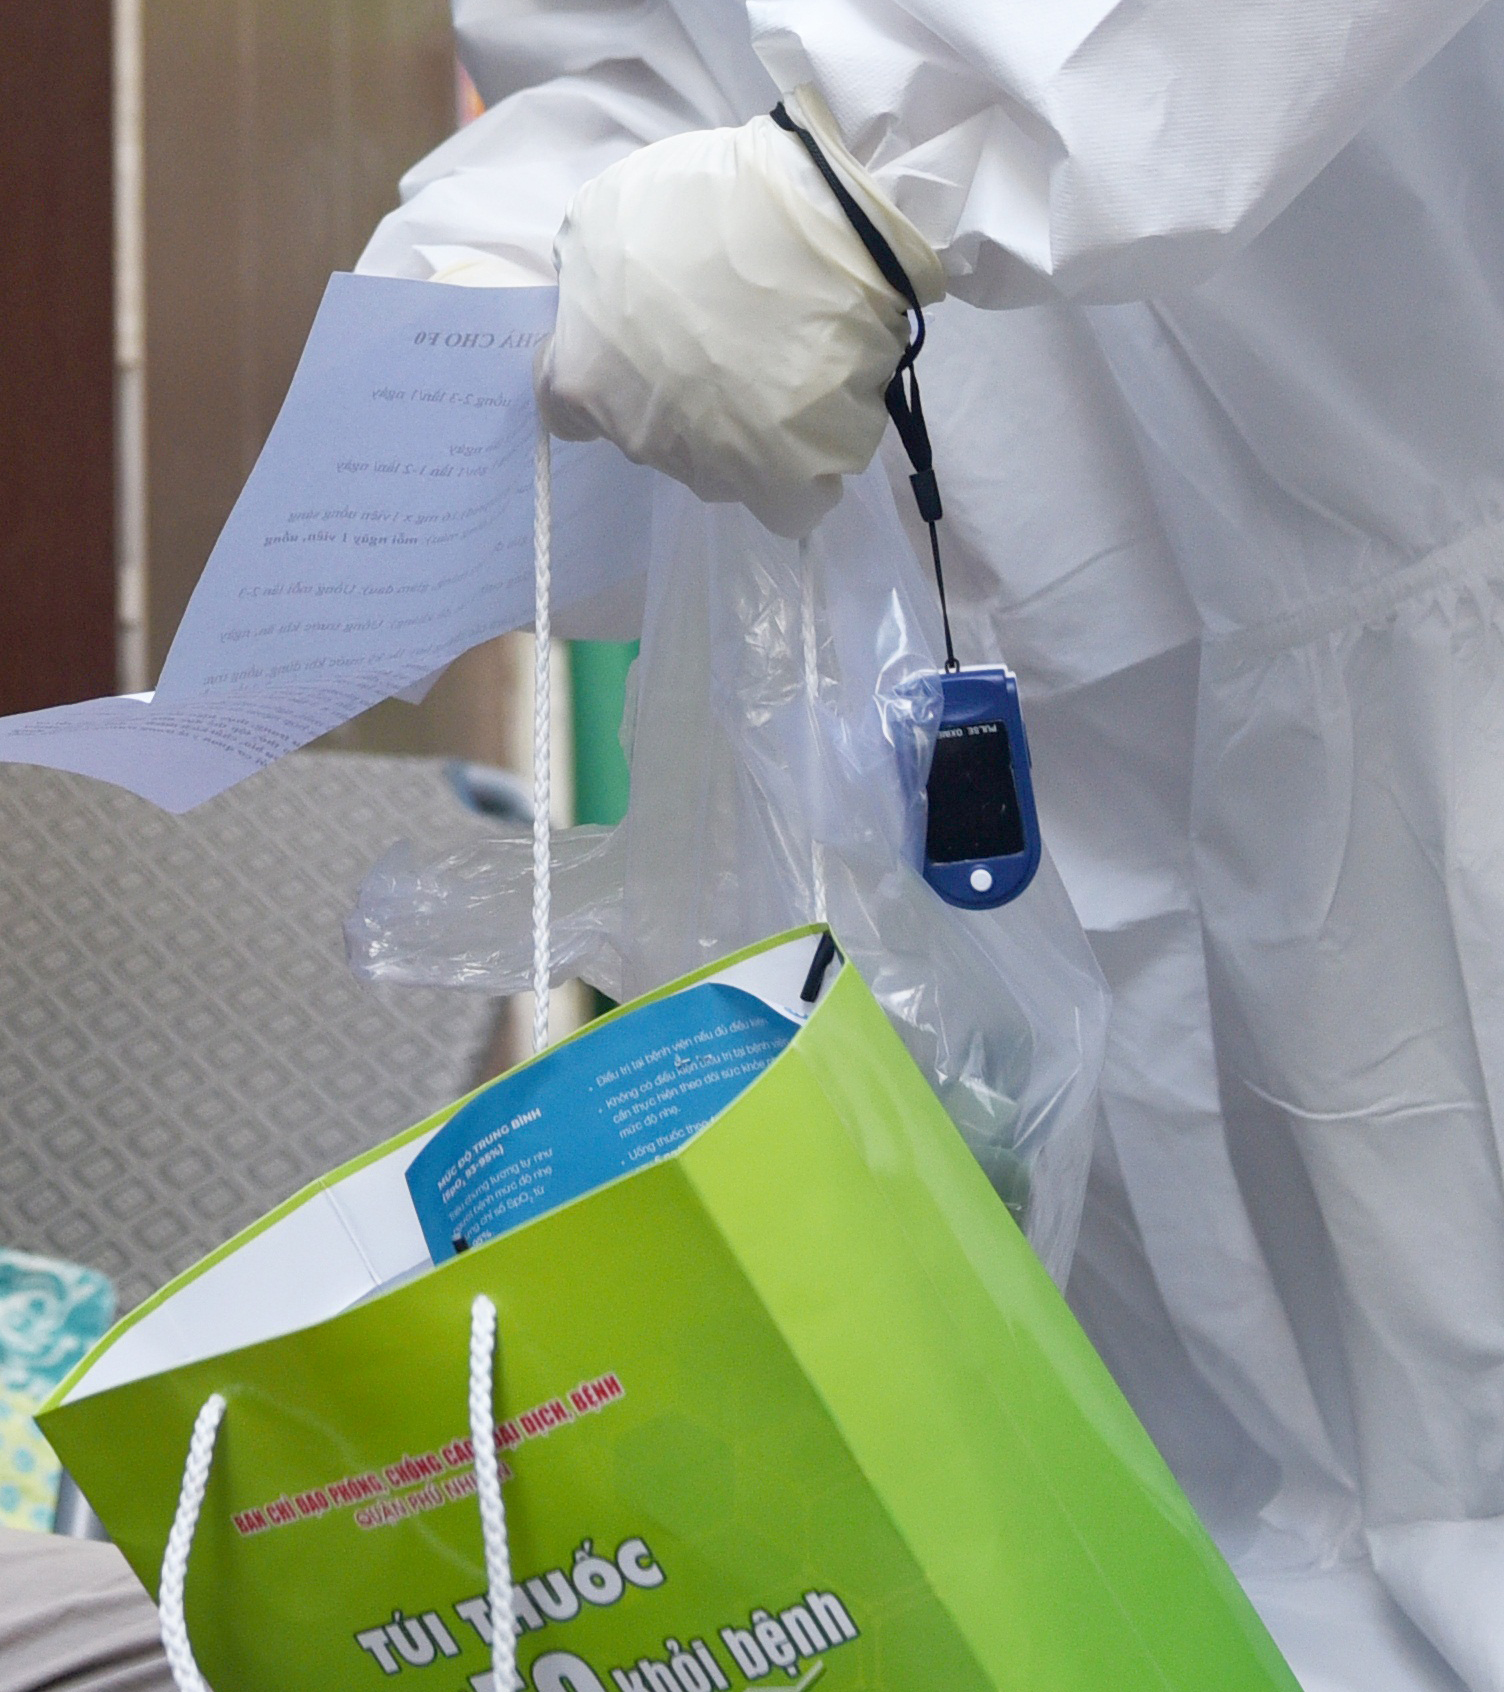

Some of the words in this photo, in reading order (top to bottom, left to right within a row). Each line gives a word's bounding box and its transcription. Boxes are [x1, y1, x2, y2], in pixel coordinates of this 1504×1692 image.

[645, 1046, 671, 1066] bệnh
[437, 1163, 458, 1191] MỨC
[472, 1124, 510, 1155] TRUNG
[510, 1107, 542, 1131] BÌNH
[232, 1511, 269, 1536] BAN
[567, 1372, 625, 1414] BỆNH
[406, 1480, 444, 1513] PHÚ
[356, 1610, 460, 1676] TÚI
[455, 1537, 666, 1644] THUỐC
[721, 1588, 860, 1678] bệnh
